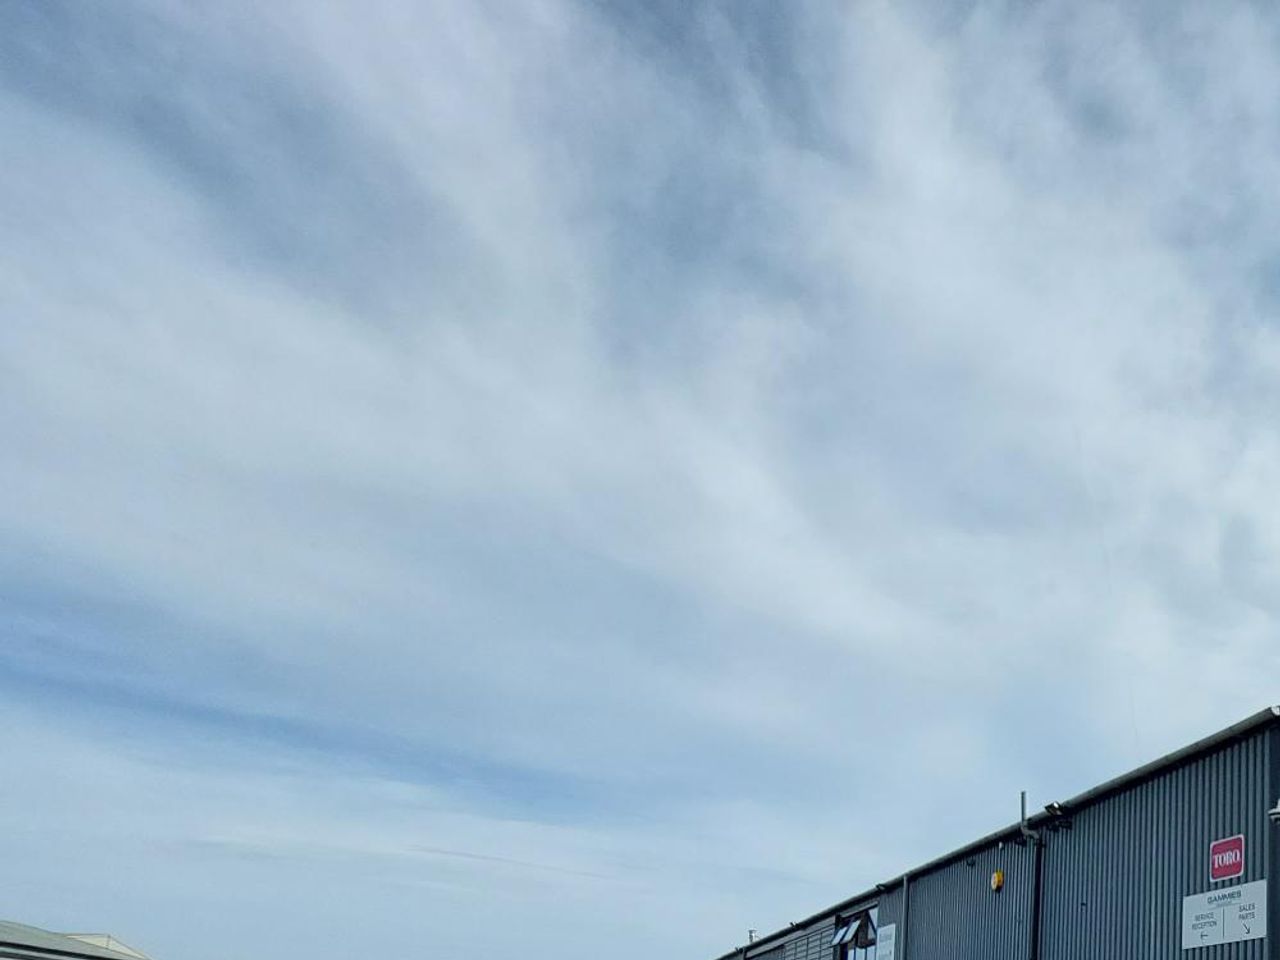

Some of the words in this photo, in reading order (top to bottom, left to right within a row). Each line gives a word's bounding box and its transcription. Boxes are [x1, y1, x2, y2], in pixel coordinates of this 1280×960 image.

[1212, 848, 1241, 869] TORO
[1207, 889, 1242, 905] GAMMIES
[1239, 902, 1256, 912] SALES
[1238, 911, 1256, 920] PARTS
